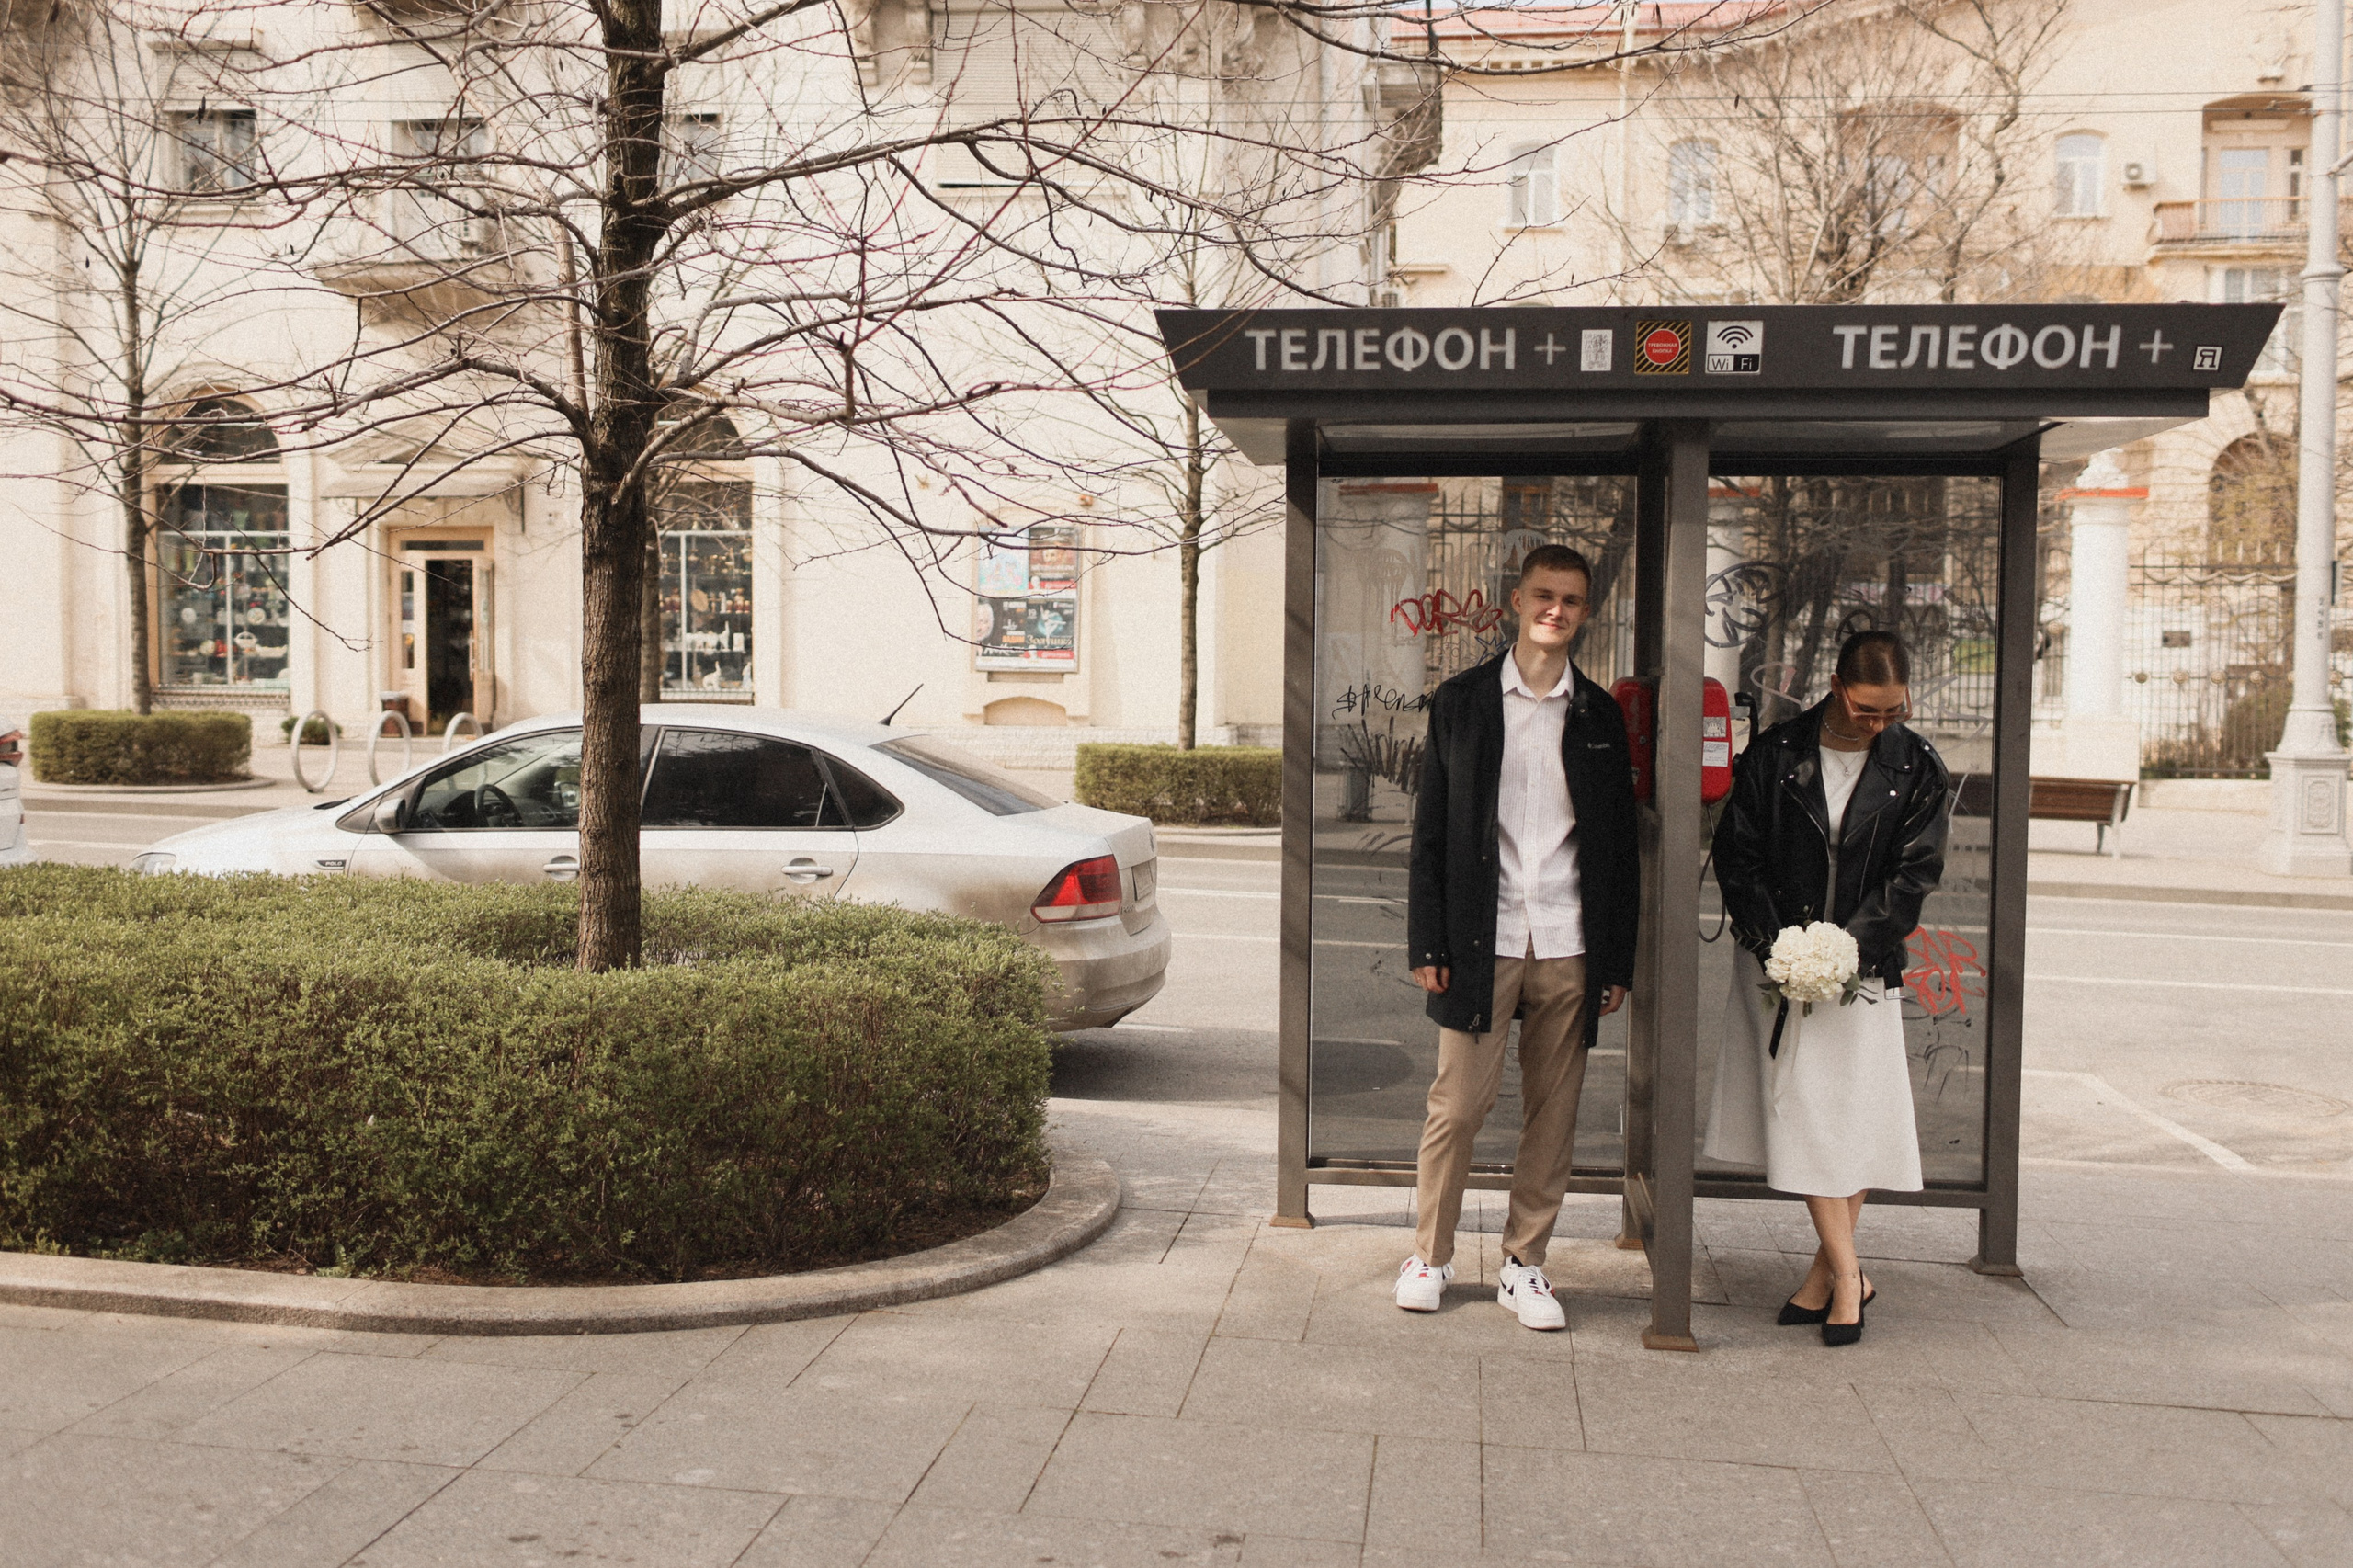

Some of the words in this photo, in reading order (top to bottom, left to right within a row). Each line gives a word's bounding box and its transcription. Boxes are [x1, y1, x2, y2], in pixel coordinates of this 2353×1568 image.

[1244, 326, 1517, 372] ТЕЛЕФОН
[1711, 358, 1729, 370] Wi
[1740, 358, 1753, 370] Fi
[1832, 323, 2121, 370] ТЕЛЕФОН
